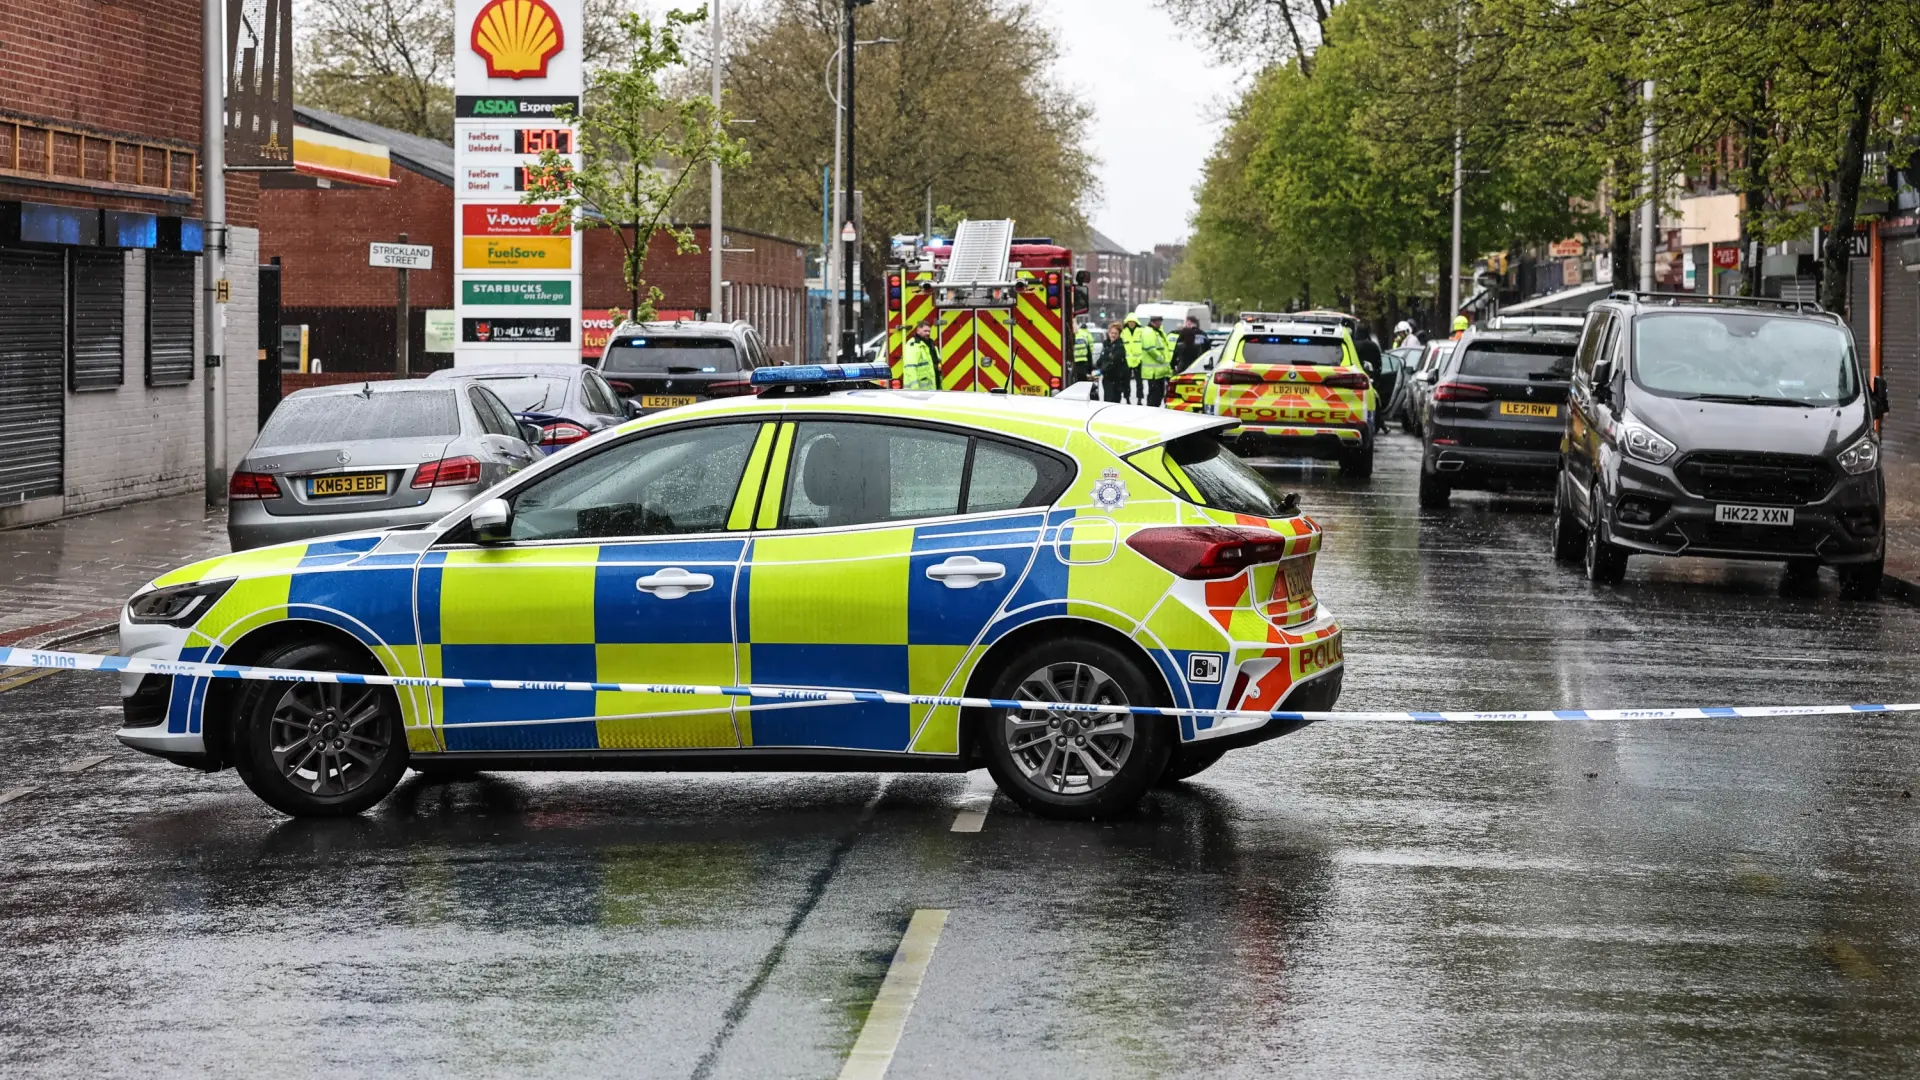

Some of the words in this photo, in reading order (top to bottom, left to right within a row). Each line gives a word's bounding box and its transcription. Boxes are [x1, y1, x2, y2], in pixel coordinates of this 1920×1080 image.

[473, 99, 518, 114] ASDA
[520, 102, 563, 113] Expre
[468, 132, 499, 141] FuelSave
[522, 129, 572, 154] 150.7
[468, 144, 502, 152] Unleaded
[468, 170, 499, 178] FuelSave
[468, 181, 490, 190] Diesel
[487, 214, 541, 225] V-Powe
[373, 246, 430, 257] STRICKLAND
[488, 247, 545, 258] FuelSave
[384, 255, 418, 265] STREET
[218, 281, 229, 300] H
[473, 284, 542, 293] STARBUCKS
[537, 292, 551, 300] the
[552, 293, 563, 301] go
[582, 319, 614, 329] oves
[648, 397, 670, 406] LE21
[1506, 403, 1528, 413] LE21
[1236, 408, 1347, 420] POLICE
[316, 474, 352, 492] KM63
[357, 473, 383, 491] EBF
[1722, 507, 1758, 522] HK22
[1762, 509, 1788, 523] XXN
[1300, 638, 1343, 673] POLIC
